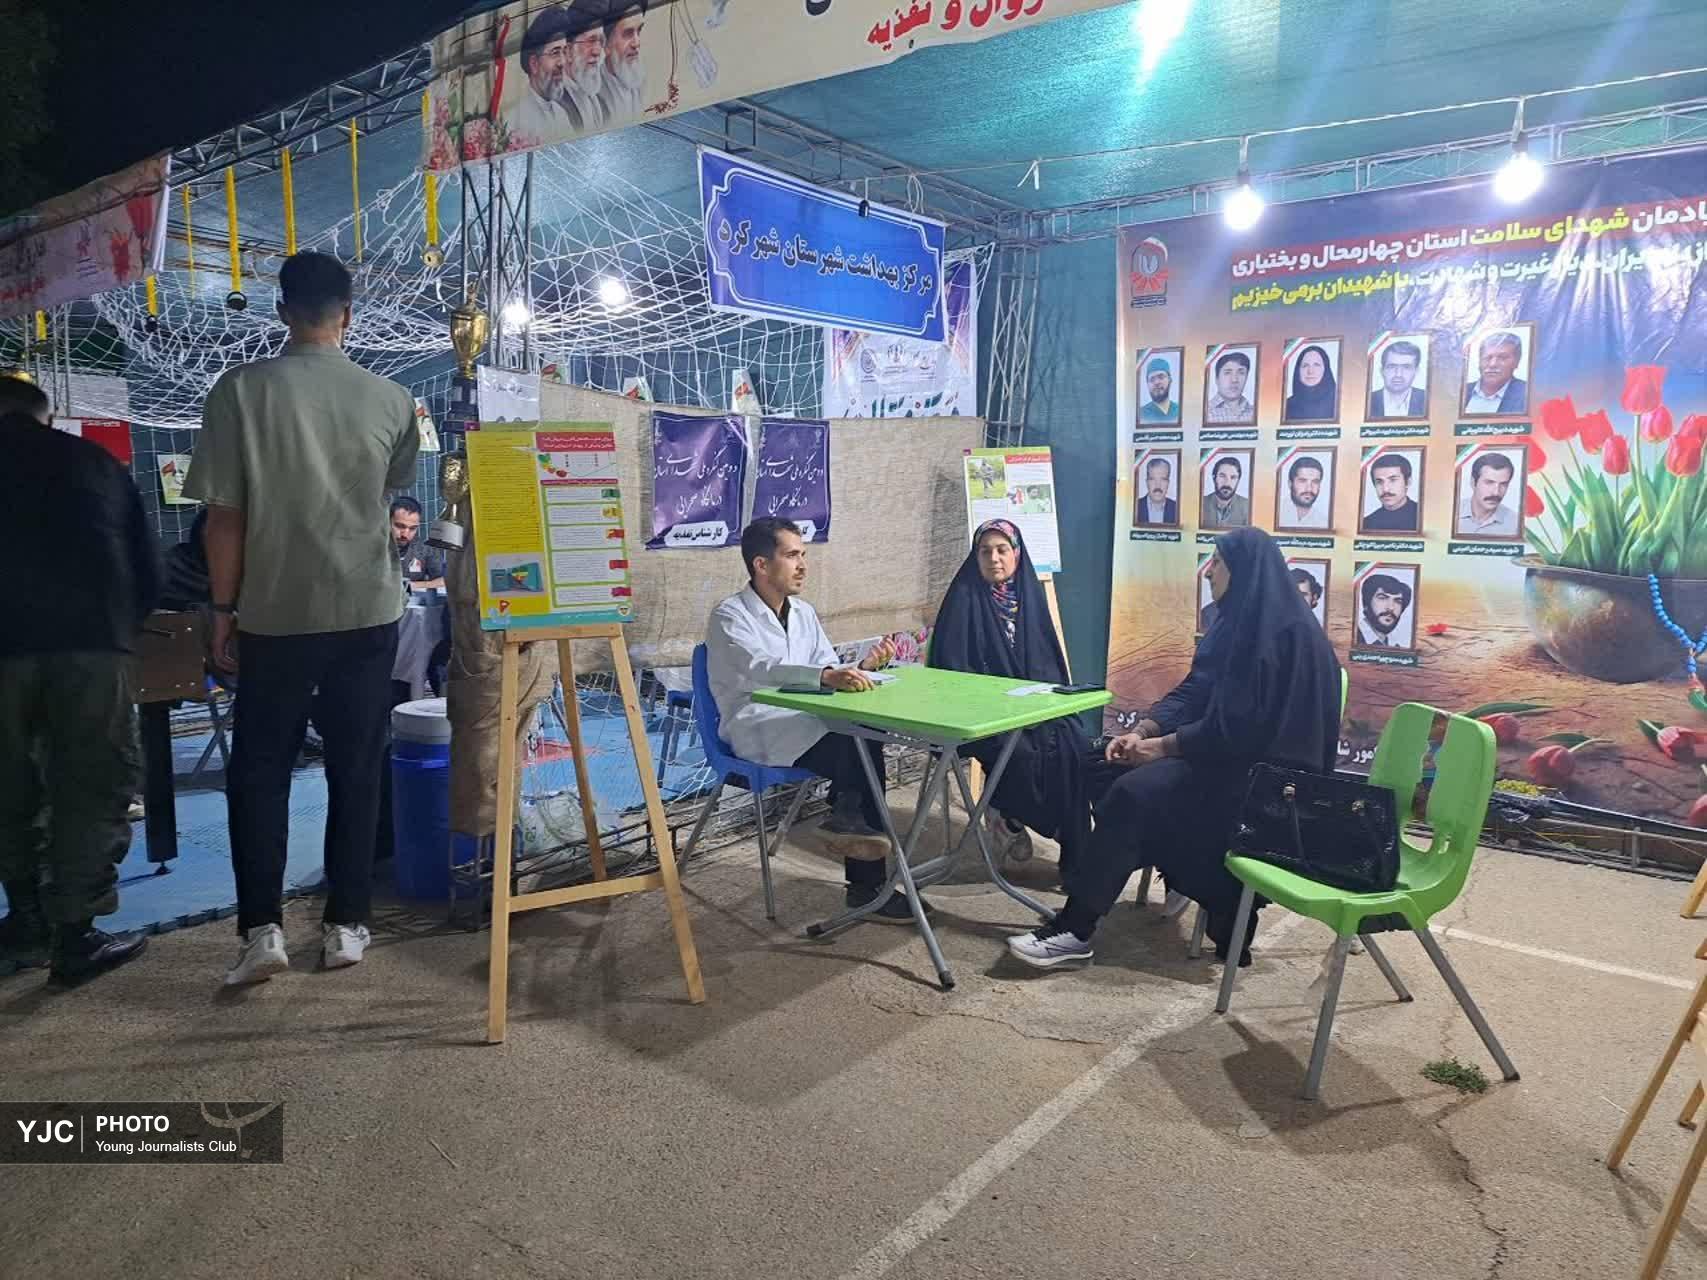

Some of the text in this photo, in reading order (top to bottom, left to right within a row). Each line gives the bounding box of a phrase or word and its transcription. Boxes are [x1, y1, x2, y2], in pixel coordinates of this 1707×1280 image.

[1470, 222, 1542, 246] سلامت
[1544, 207, 1630, 243] شهدای
[1312, 239, 1404, 269] چهارمحال
[1405, 229, 1468, 258] استان
[1231, 250, 1298, 277] بختیاری
[1298, 252, 1312, 271] و
[1323, 269, 1394, 301] شهیدان
